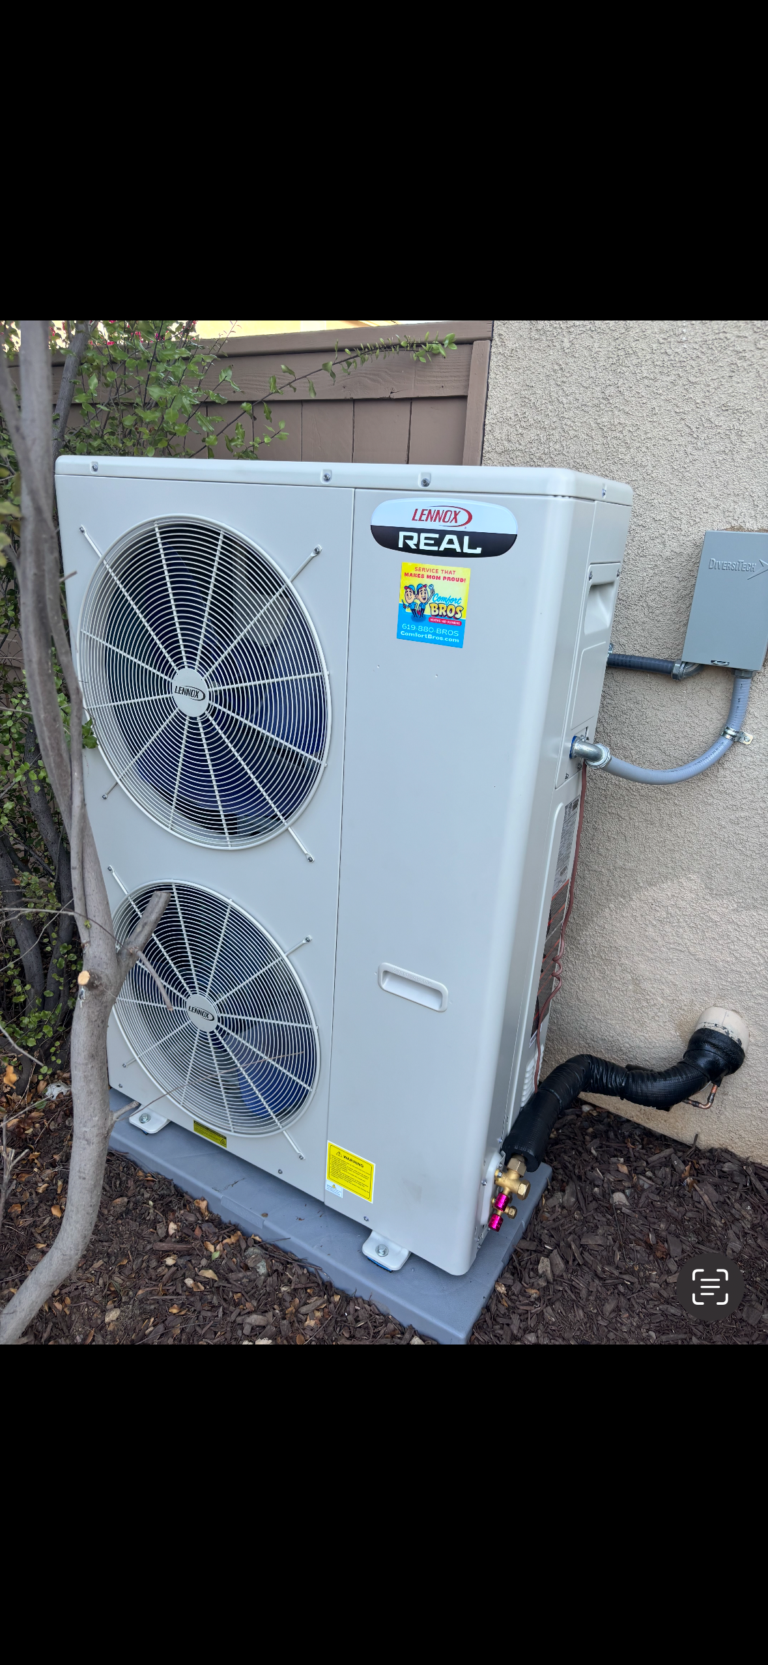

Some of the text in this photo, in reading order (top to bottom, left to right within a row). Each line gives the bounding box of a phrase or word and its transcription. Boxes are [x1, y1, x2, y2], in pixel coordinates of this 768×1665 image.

[411, 508, 461, 524] LENNOX
[398, 531, 482, 554] REAL
[414, 566, 439, 575] SERVICE
[432, 593, 462, 606] Comfort
[429, 602, 464, 620] BROS
[400, 630, 460, 643] ComfortBros.com
[174, 685, 200, 699] LENNOX
[188, 1005, 210, 1019] LENNOX
